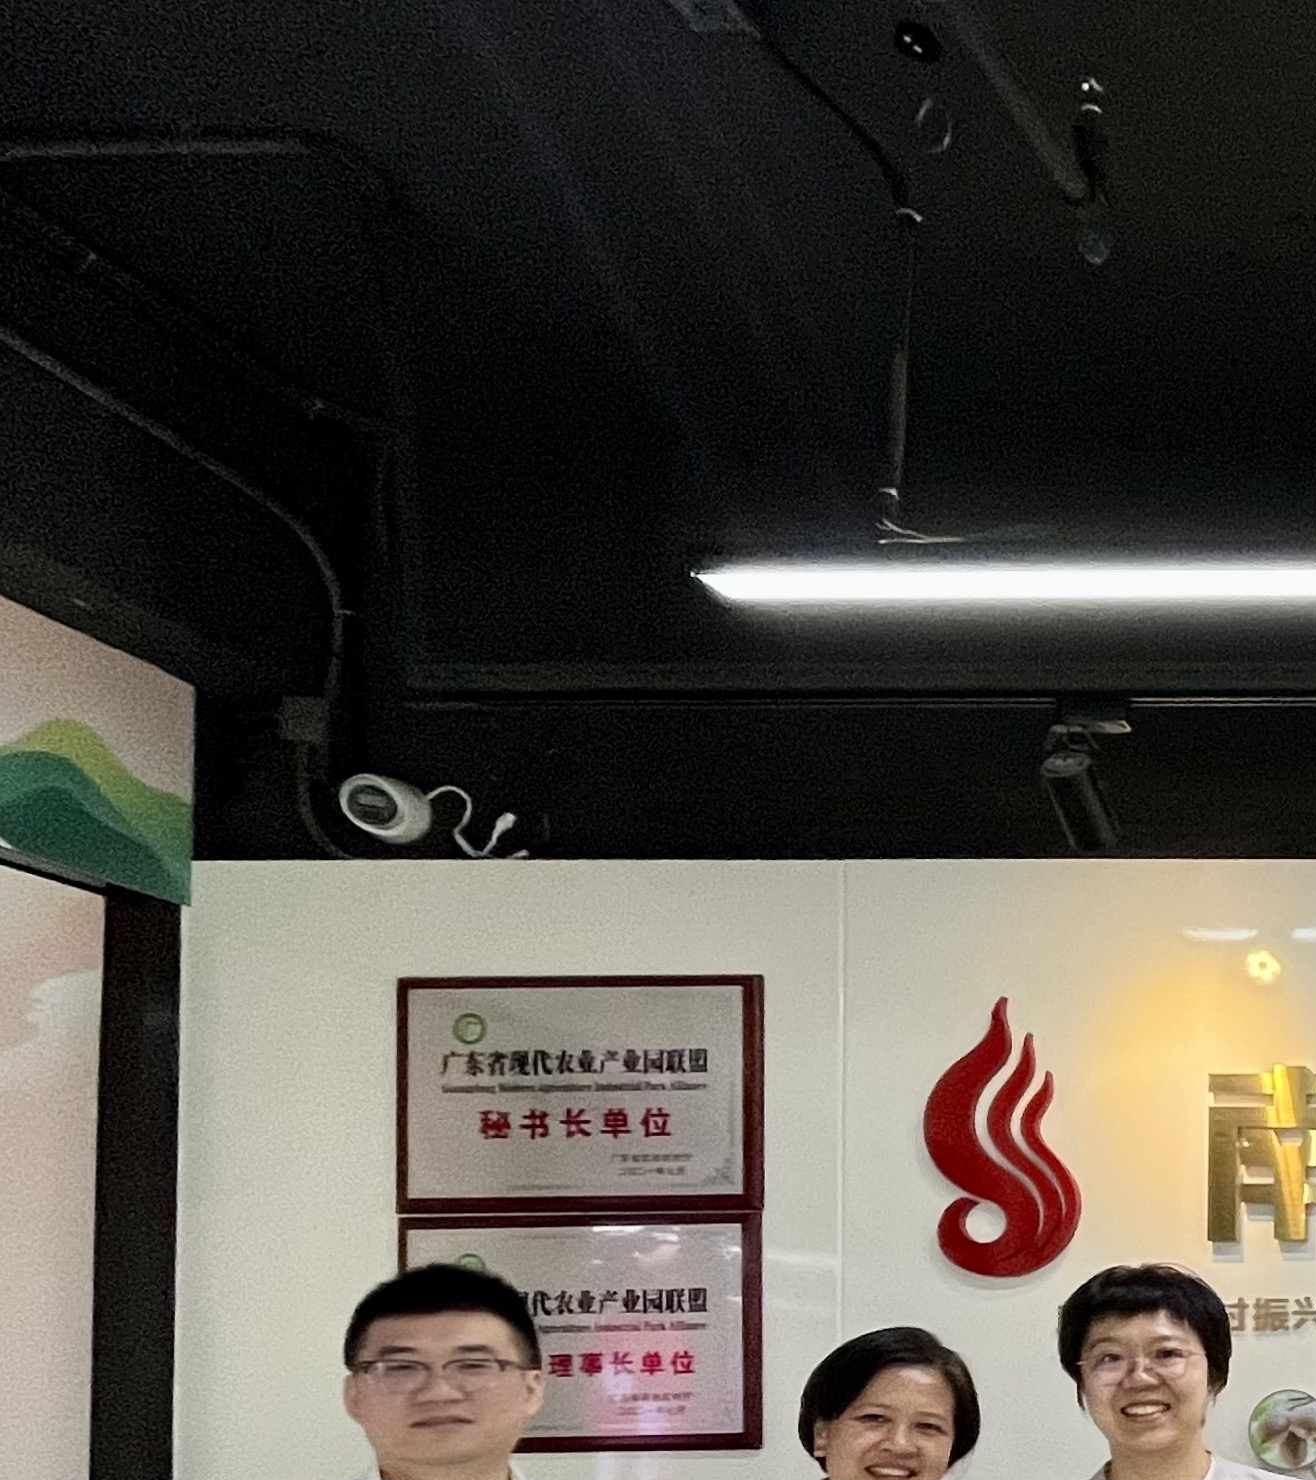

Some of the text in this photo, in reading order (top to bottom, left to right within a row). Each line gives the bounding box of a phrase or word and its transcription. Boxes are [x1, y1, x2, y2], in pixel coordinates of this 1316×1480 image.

[478, 1107, 671, 1140] 秘书长单位
